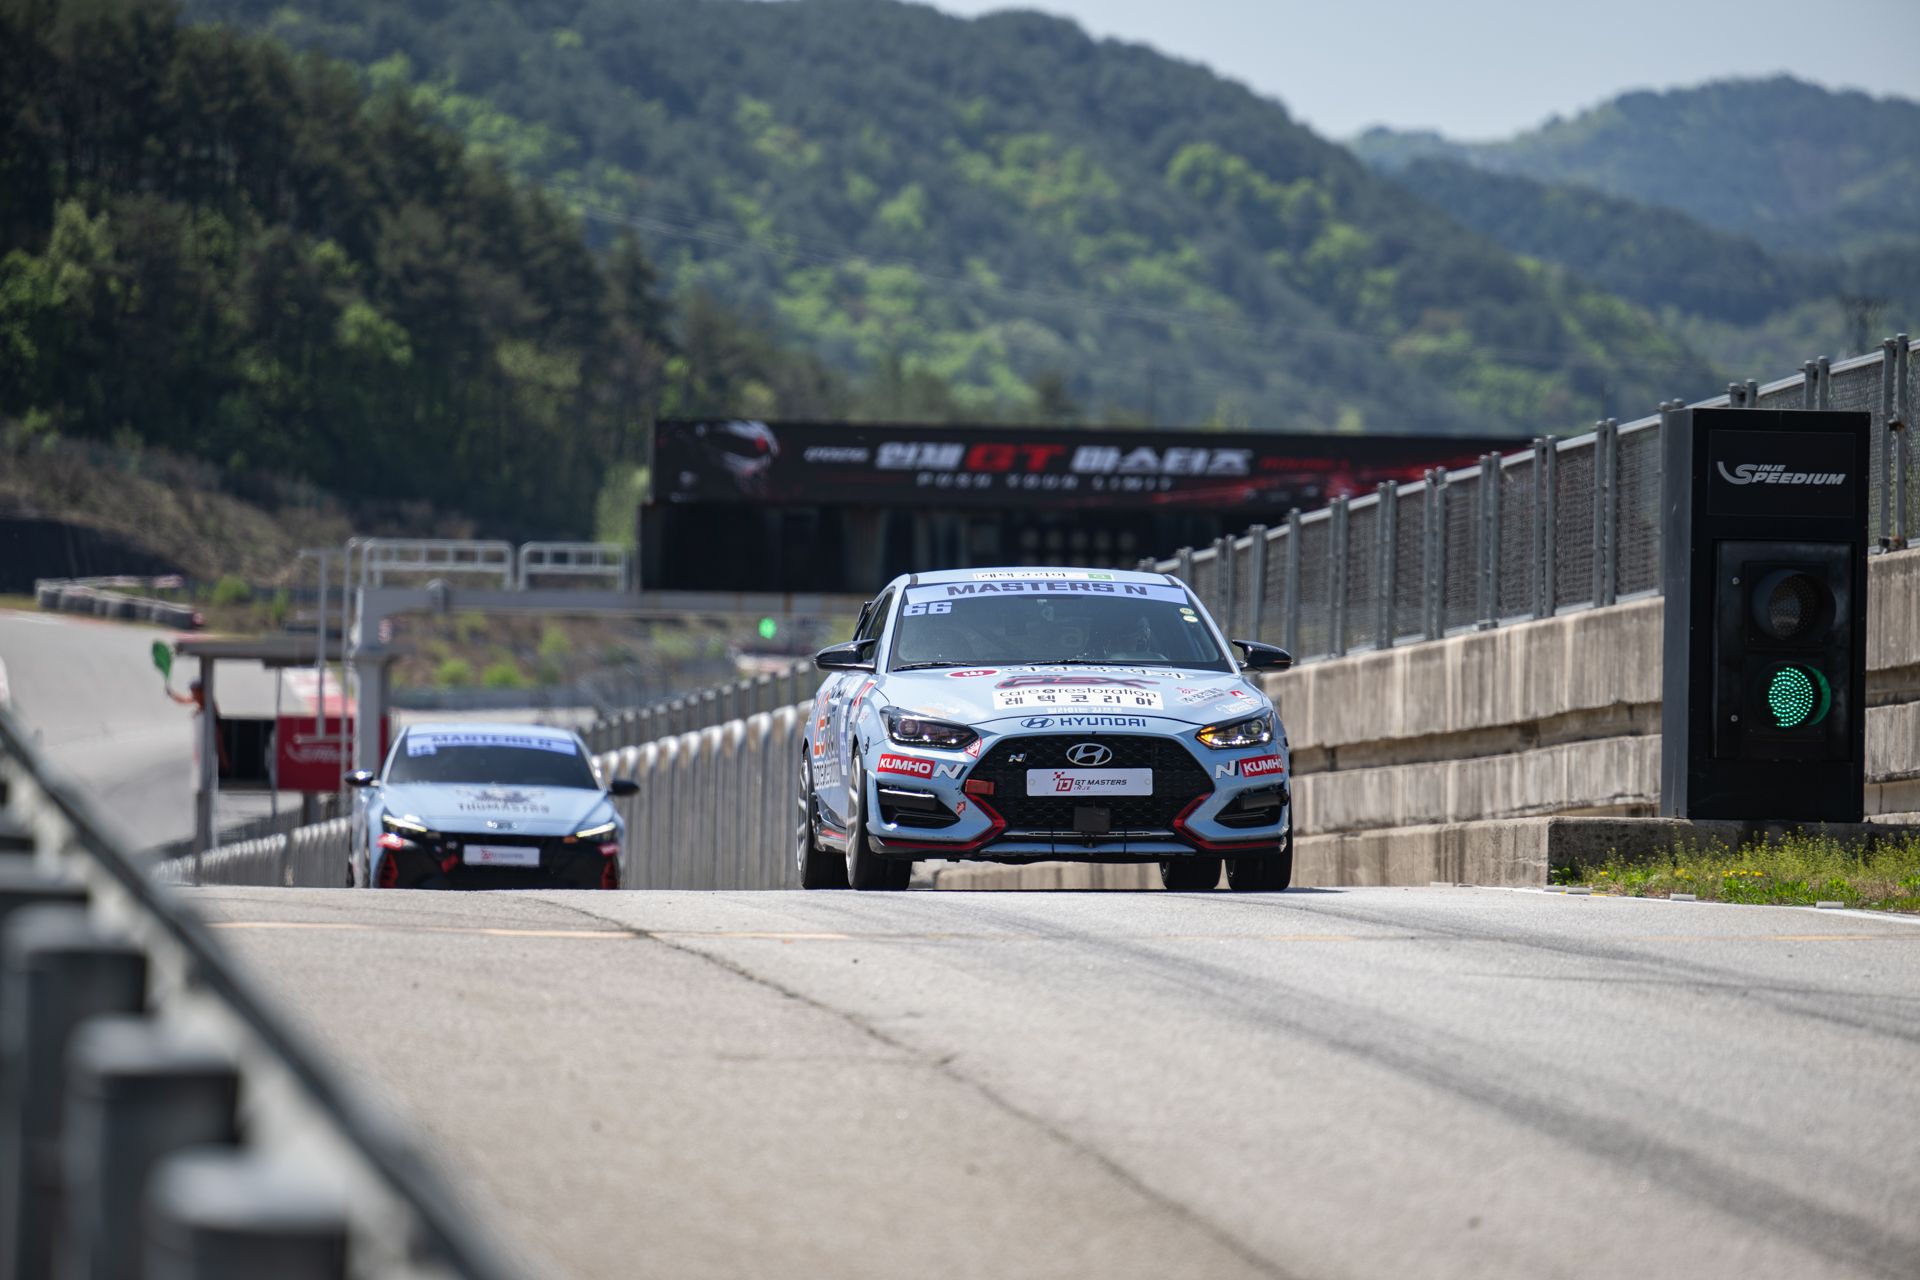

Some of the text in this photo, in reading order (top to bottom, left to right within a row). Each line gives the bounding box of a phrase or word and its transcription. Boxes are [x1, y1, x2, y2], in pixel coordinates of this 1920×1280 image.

[966, 442, 1067, 472] GT
[1069, 446, 1252, 475] 마스터즈
[1717, 461, 1846, 485] SPEEDIUM
[1757, 464, 1786, 472] INJE
[946, 581, 1148, 596] MASTERS N
[902, 601, 953, 617] 66
[1060, 717, 1147, 727] HYUNDAI
[879, 758, 932, 774] KUMHO
[1243, 758, 1284, 775] KUMHO
[1074, 779, 1087, 787] GT
